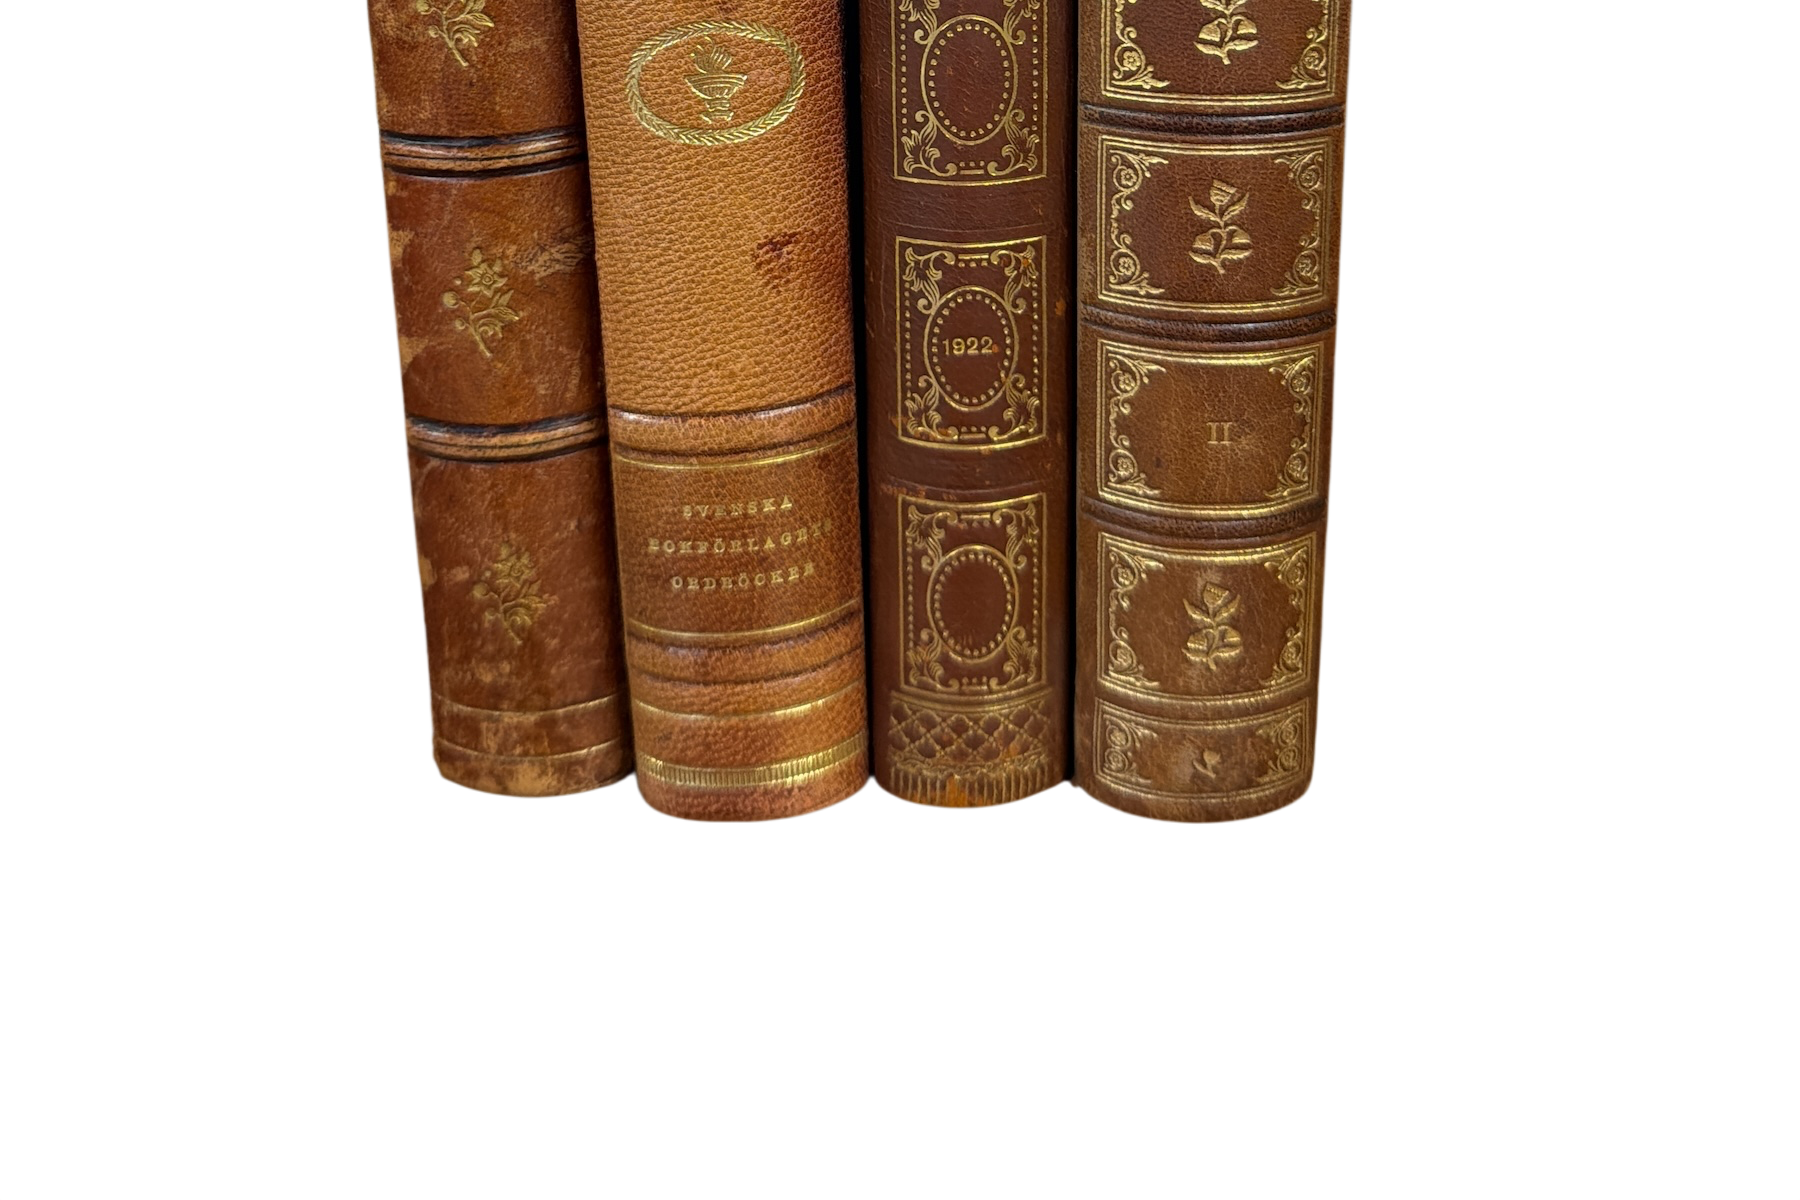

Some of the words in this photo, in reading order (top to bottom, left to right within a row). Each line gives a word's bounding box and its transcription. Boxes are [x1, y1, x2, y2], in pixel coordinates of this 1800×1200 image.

[942, 336, 994, 356] 1922
[1206, 421, 1233, 444] II
[682, 495, 793, 517] SVENSKA
